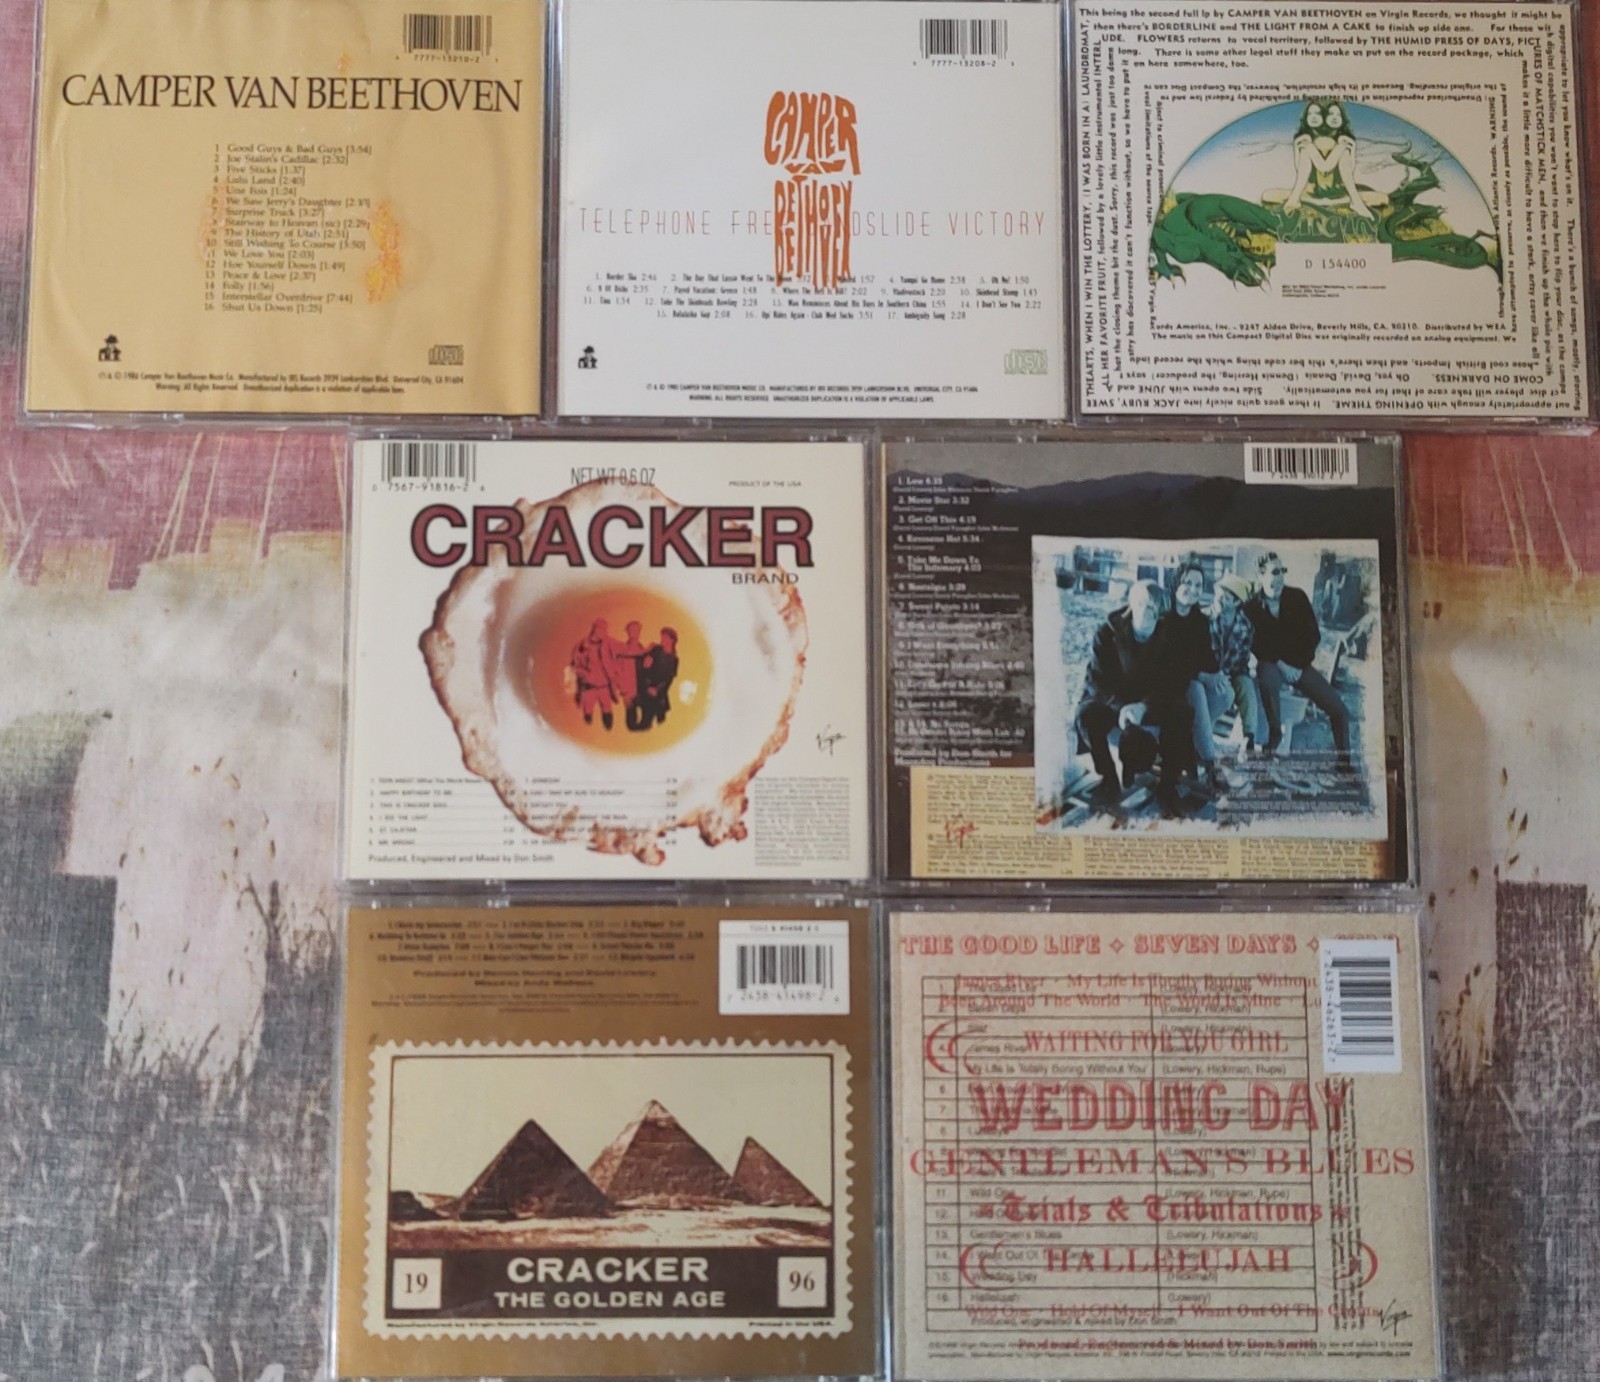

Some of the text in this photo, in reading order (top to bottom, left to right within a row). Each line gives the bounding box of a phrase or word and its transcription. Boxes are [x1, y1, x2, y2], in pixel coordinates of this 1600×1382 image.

[1079, 8, 1099, 17] This
[1102, 9, 1127, 19] being
[1131, 9, 1145, 17] the
[1149, 9, 1179, 17] second
[1183, 9, 1199, 17] full
[1202, 9, 1210, 19] lp
[1214, 9, 1224, 19] by
[1228, 9, 1270, 18] CAMPER
[1274, 9, 1297, 18] VAN
[1301, 9, 1362, 18] BEETHOVEN
[1380, 10, 1409, 20] Virgin
[1470, 10, 1506, 21] thought
[1511, 10, 1518, 19] it
[1521, 11, 1548, 21] might
[1551, 11, 1562, 20] be
[1093, 22, 1114, 31] then
[1118, 22, 1149, 31] there's
[1152, 23, 1216, 31] BORDERLINE
[1220, 23, 1237, 31] and
[1241, 23, 1261, 31] THE
[1264, 23, 1295, 31] LIGHT
[1300, 23, 1328, 31] FROM
[1332, 23, 1340, 31] A
[1343, 23, 1371, 31] CAKE
[1389, 23, 1414, 32] finish
[1418, 25, 1429, 33] up
[1433, 24, 1450, 32] side
[1491, 24, 1505, 32] For
[1509, 24, 1533, 32] those
[1137, 35, 1185, 43] FLOWERS
[1188, 36, 1220, 44] returns
[1242, 36, 1267, 44] vocal
[1315, 36, 1353, 44] followed
[1357, 37, 1367, 46] by
[1371, 37, 1391, 45] THE
[1395, 37, 1431, 45] HUMID
[1435, 37, 1463, 45] PRESS
[1467, 37, 1479, 45] OF
[62, 74, 522, 112] CAMPER VAN BEETHOVEN
[1535, 88, 1546, 155] MATCHSTICK
[764, 90, 861, 175] CAMPER
[228, 144, 254, 152] Good
[257, 144, 282, 154] Guys
[318, 145, 342, 154] Guys
[227, 155, 241, 164] Joe
[245, 155, 278, 163] Stalin's
[281, 156, 318, 164] Cadillac
[784, 159, 846, 174] VAN
[580, 207, 712, 236] TELEPHONE
[949, 212, 1046, 237] VICTORY
[1084, 255, 1092, 271] THE
[1305, 258, 1367, 269] D 154400
[223, 271, 248, 279] Peace
[1084, 278, 1093, 301] WIN
[717, 299, 737, 308] Bowling
[1085, 310, 1093, 343] WHEN
[1493, 375, 1510, 384] ON
[1514, 375, 1544, 384] COME
[571, 467, 593, 486] NET
[597, 467, 616, 486] WT
[640, 468, 656, 487] OZ
[410, 504, 815, 568] CRACKER
[731, 572, 799, 585] BRAND
[411, 854, 453, 865] Engineered
[457, 854, 473, 863] and
[476, 854, 499, 863] Mixed
[502, 854, 512, 865] by
[514, 854, 529, 863] Don
[533, 854, 554, 863] Smith
[900, 933, 1296, 955] THE GOOD LIFE SEVEN DAYS
[1024, 1030, 1289, 1053] WAITING FOR YOU GIRL
[985, 1063, 1003, 1073] Life
[1019, 1063, 1048, 1075] Totally
[1052, 1063, 1084, 1075] Boring
[1087, 1063, 1124, 1073] Without
[1128, 1063, 1146, 1073] You
[968, 1078, 1350, 1132] WEDDING DAY
[1265, 1147, 1415, 1176] BLUES
[1001, 1193, 1323, 1225] Trials & Tribulations
[1044, 1246, 1290, 1273] HALLELUJAH
[507, 1257, 709, 1283] CRACKER
[404, 1273, 427, 1293] 19
[789, 1270, 815, 1292] 96
[495, 1291, 726, 1308] THE GOLDEN AGE
